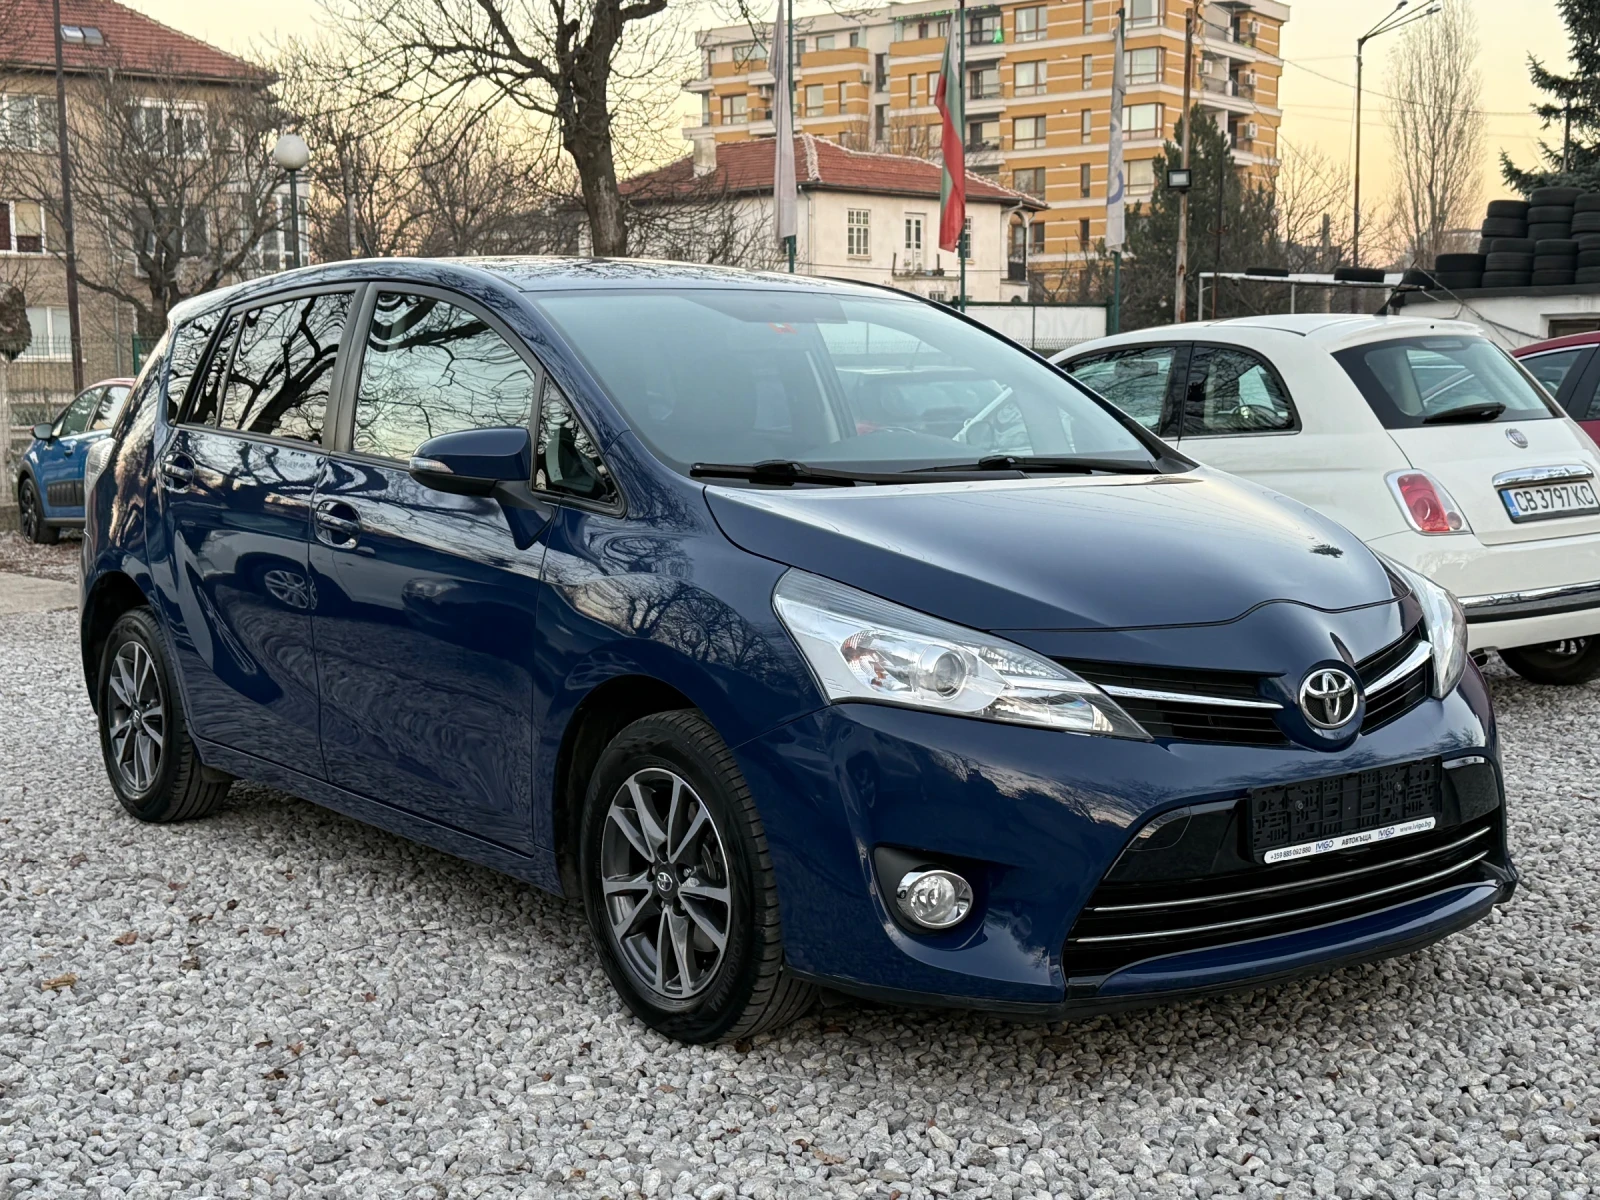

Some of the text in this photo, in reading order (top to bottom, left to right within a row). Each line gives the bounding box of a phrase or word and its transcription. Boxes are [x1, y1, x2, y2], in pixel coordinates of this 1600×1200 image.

[1514, 491, 1538, 512] CB
[1536, 486, 1571, 509] 3797
[1570, 485, 1593, 505] KC
[1315, 840, 1334, 850] IVIGO
[1341, 834, 1372, 846] АВТОКЪЩА
[1378, 827, 1395, 837] IVIGO
